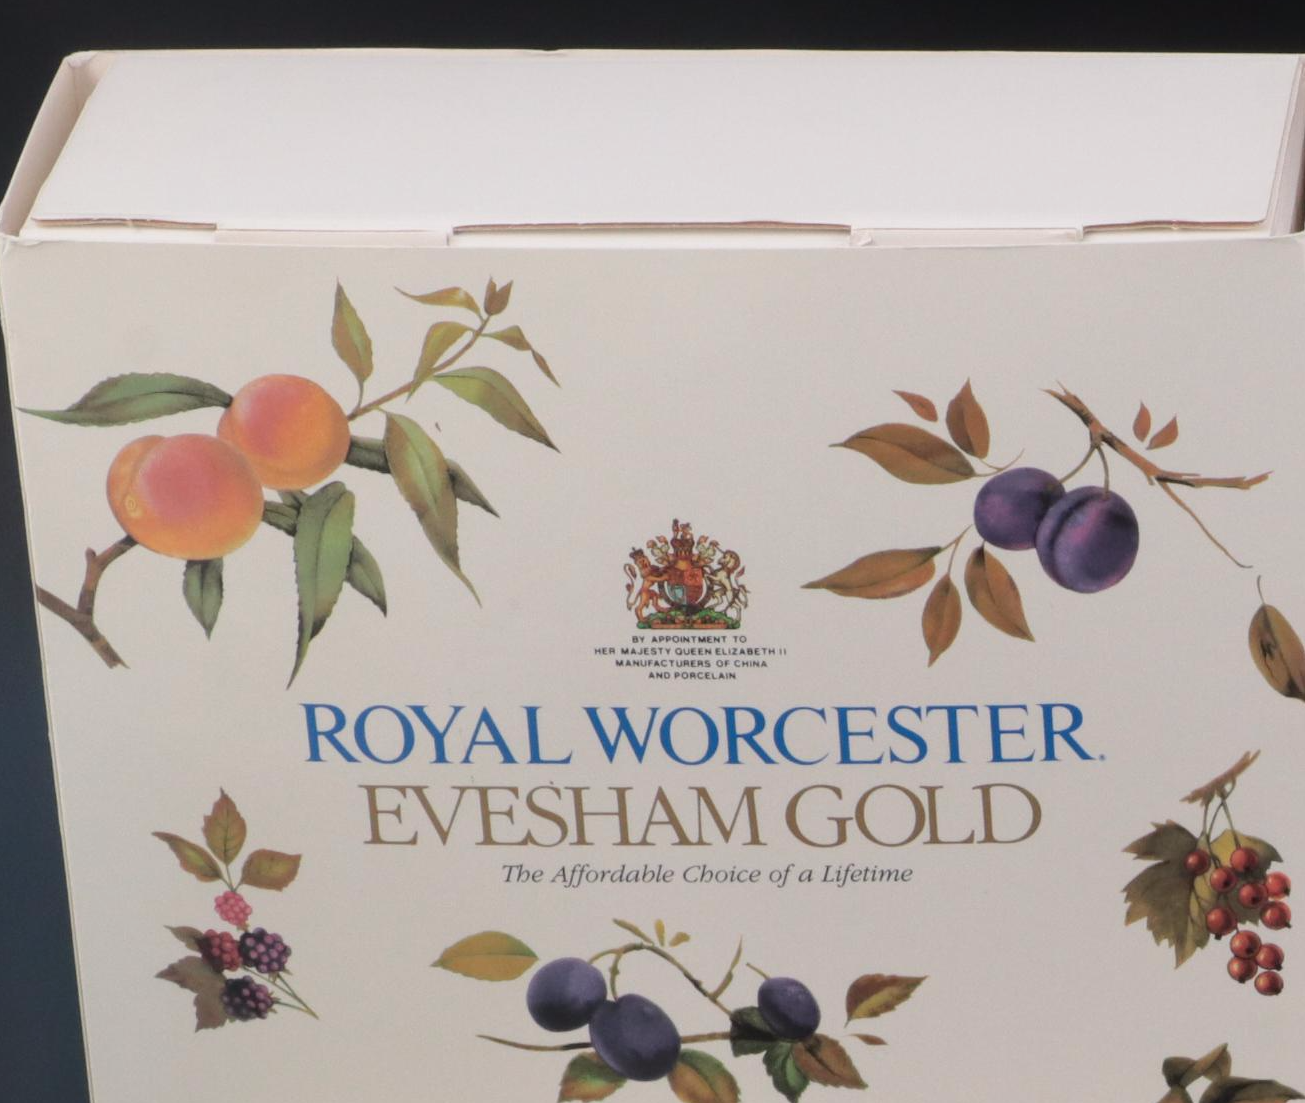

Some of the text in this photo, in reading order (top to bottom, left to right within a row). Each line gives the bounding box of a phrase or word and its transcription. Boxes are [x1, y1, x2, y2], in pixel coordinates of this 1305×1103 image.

[632, 635, 748, 644] BY APPOINTMENT TO
[594, 647, 787, 656] HER MAJESTY QUEEN ELIZABETH II
[615, 659, 768, 668] MANUFACTURERS OF CHINA
[648, 671, 736, 680] AND PORCELAIN
[302, 703, 572, 764] ROYAL
[358, 781, 1042, 848] EVESHAM GOLD
[502, 863, 914, 889] The Affordable Choice of a Lifetime
